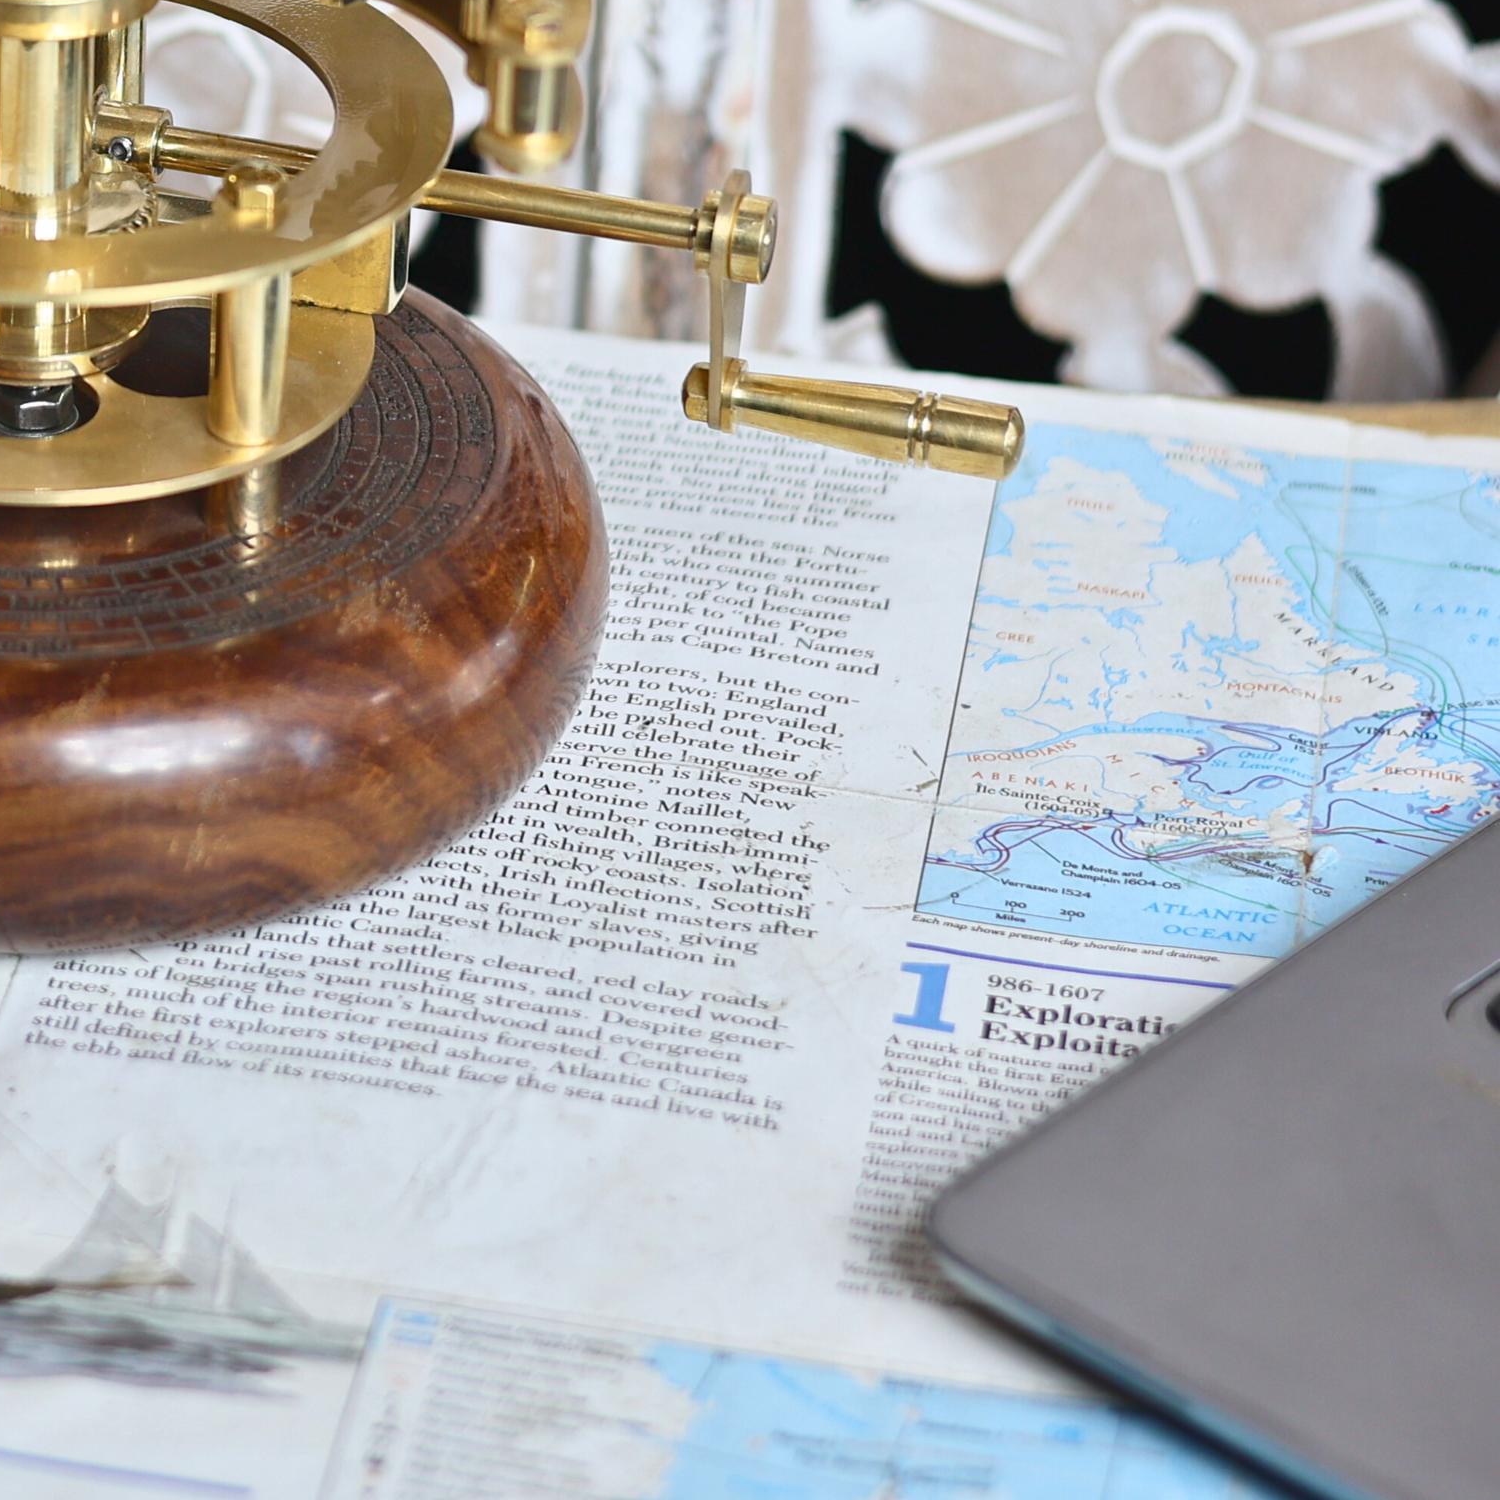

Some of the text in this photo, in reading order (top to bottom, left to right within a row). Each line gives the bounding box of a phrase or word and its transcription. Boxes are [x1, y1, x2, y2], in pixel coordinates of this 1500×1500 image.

[1077, 582, 1146, 600] NASKAPI
[625, 596, 695, 614] drunk
[703, 607, 724, 619] to
[789, 620, 847, 638] Pope
[648, 618, 874, 658] per quintal. Names
[996, 631, 1036, 645] CREE
[651, 634, 879, 676] as Cape Breton and
[639, 679, 826, 717] to two: England
[717, 671, 860, 704] but the con-
[590, 705, 842, 751] be pushed out. Pock-
[626, 693, 844, 738] English prevailed,
[571, 723, 801, 762] still celebrate their
[1353, 725, 1439, 740] VINLAND
[635, 746, 822, 781] the language of
[966, 739, 1078, 763] IROQUOIANS
[580, 756, 835, 798] French is like speak-
[972, 770, 1088, 792] ABENAKI
[1384, 765, 1466, 784] BEOTHUK
[534, 784, 750, 824] Antonine Maillet,
[666, 787, 731, 801] notes
[739, 792, 796, 811] New
[975, 782, 1101, 808] Île Sainte-Croix
[1024, 800, 1100, 818] (1604-05)
[1154, 812, 1244, 828] Port-Royal
[1152, 822, 1229, 838] (1605-07)
[494, 848, 803, 900] off rocky coasts. Isolation
[1061, 868, 1182, 891] Champlain 1604-05
[1081, 863, 1144, 879] Monts and
[1000, 877, 1092, 899] Verrazano 1524
[995, 911, 1027, 924] Miles
[1004, 899, 1027, 910] 100
[1059, 908, 1085, 919] 200
[1143, 900, 1278, 924] ATLANTIC
[498, 920, 735, 968] black population in
[911, 914, 1221, 963] Each map shows present-day shoreline and drainage.
[1162, 923, 1256, 943] OCEAN
[254, 925, 769, 1009] lands that settlers cleared, red clay roads
[126, 987, 194, 1004] much
[213, 958, 588, 1019] bridges span rushing streams.
[892, 962, 955, 1033] 1
[988, 975, 1105, 1002] 986-1607
[39, 995, 202, 1026] after the first
[884, 1046, 962, 1068] brought
[881, 1062, 1038, 1097] America. Blown
